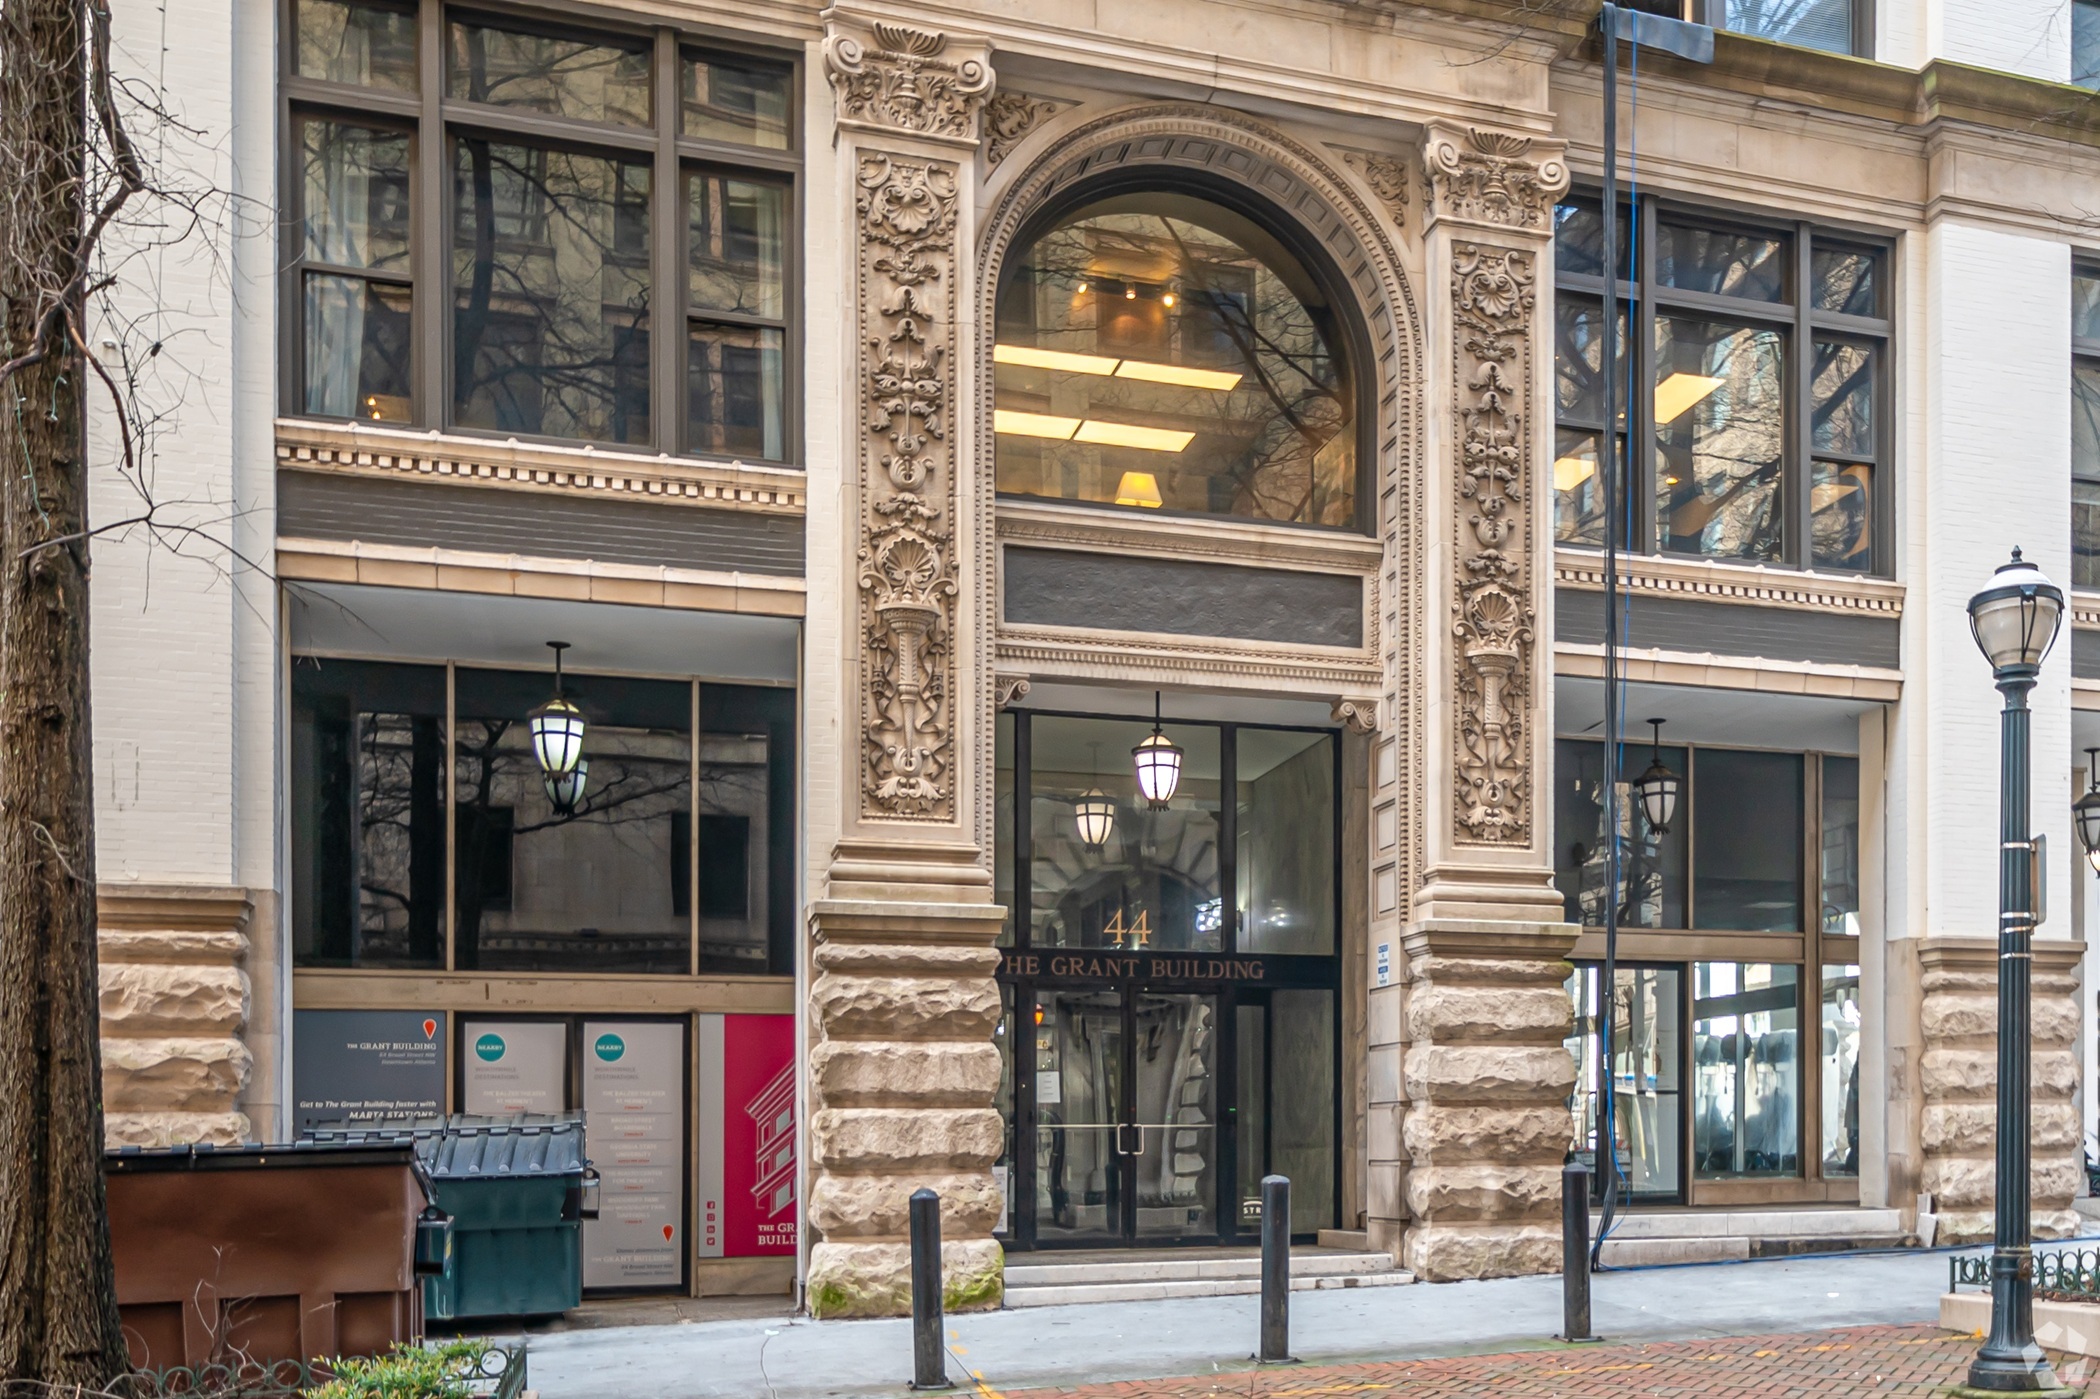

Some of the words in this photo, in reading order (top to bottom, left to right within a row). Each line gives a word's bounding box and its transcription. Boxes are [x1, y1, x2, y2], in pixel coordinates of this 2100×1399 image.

[1103, 908, 1153, 944] 44
[1006, 955, 1040, 975] HE
[1051, 957, 1140, 978] GRANT
[1151, 959, 1264, 980] BUILDING
[359, 1042, 391, 1050] GRANT
[392, 1042, 437, 1050] BUILDING
[364, 1101, 394, 1109] Building
[395, 1101, 417, 1109] faster
[349, 1111, 384, 1119] MARTA
[758, 1224, 774, 1232] THE
[777, 1222, 797, 1233] GR
[758, 1234, 797, 1245] BUILD
